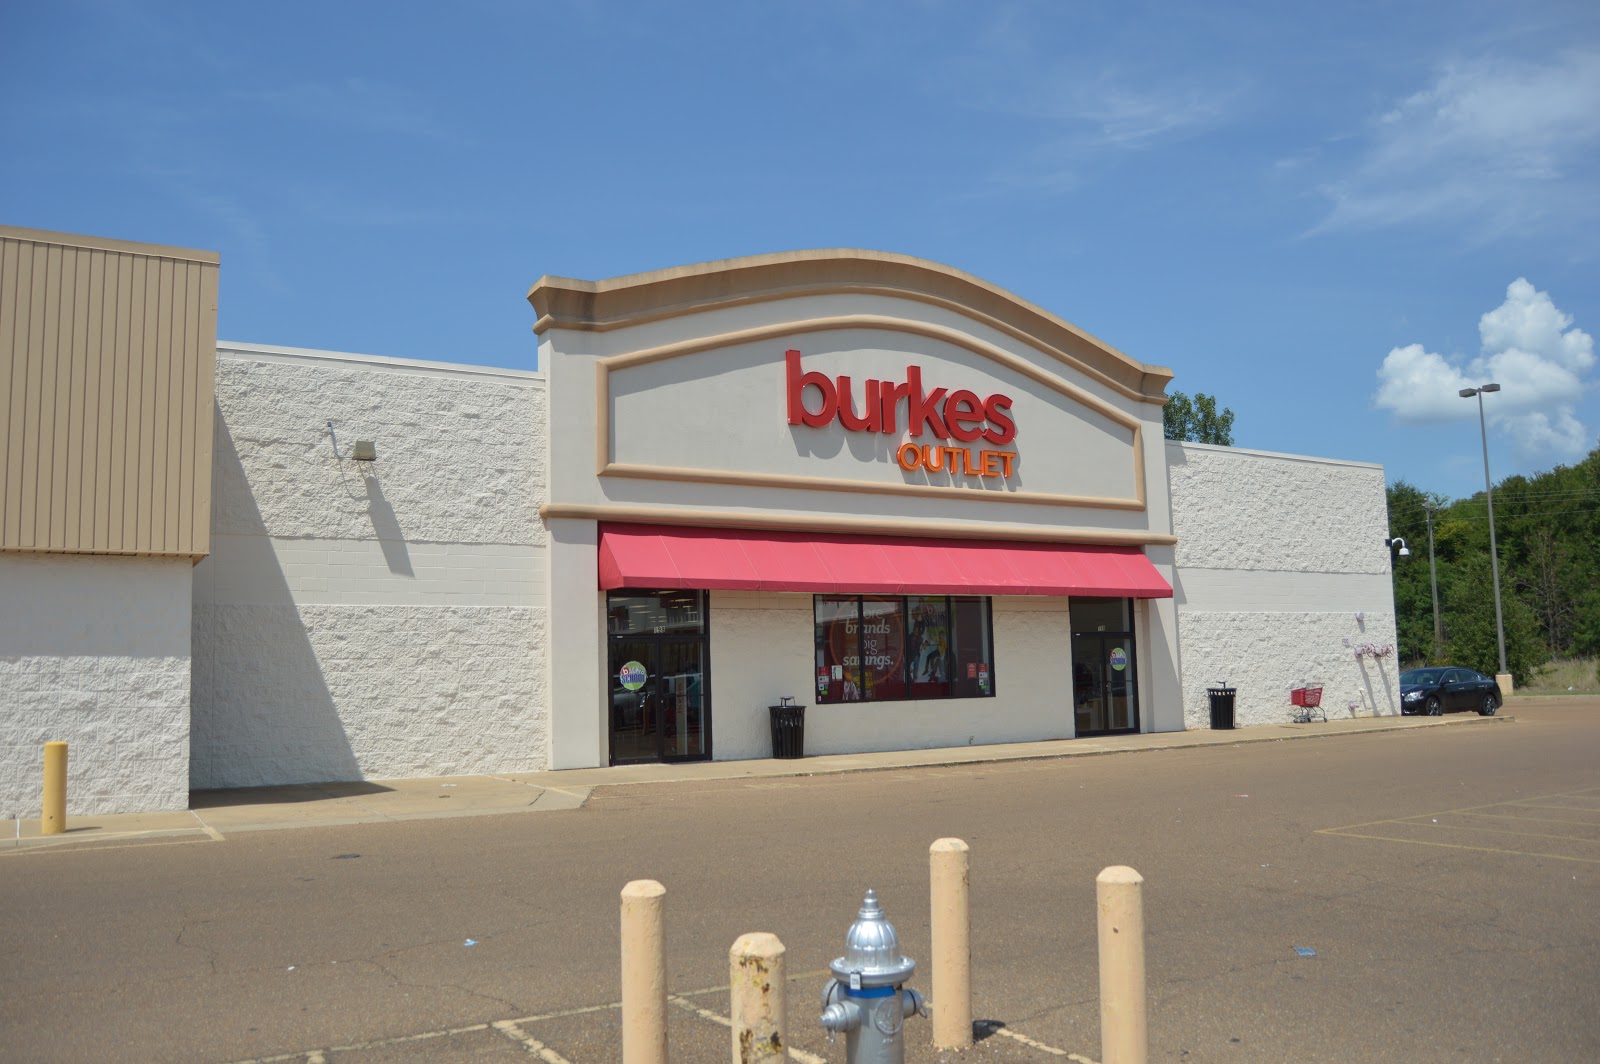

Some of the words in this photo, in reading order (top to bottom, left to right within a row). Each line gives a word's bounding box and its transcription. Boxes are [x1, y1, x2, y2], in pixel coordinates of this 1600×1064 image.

[785, 349, 1016, 445] burkes
[897, 442, 1016, 478] OUTLET
[842, 651, 894, 670] saings.
